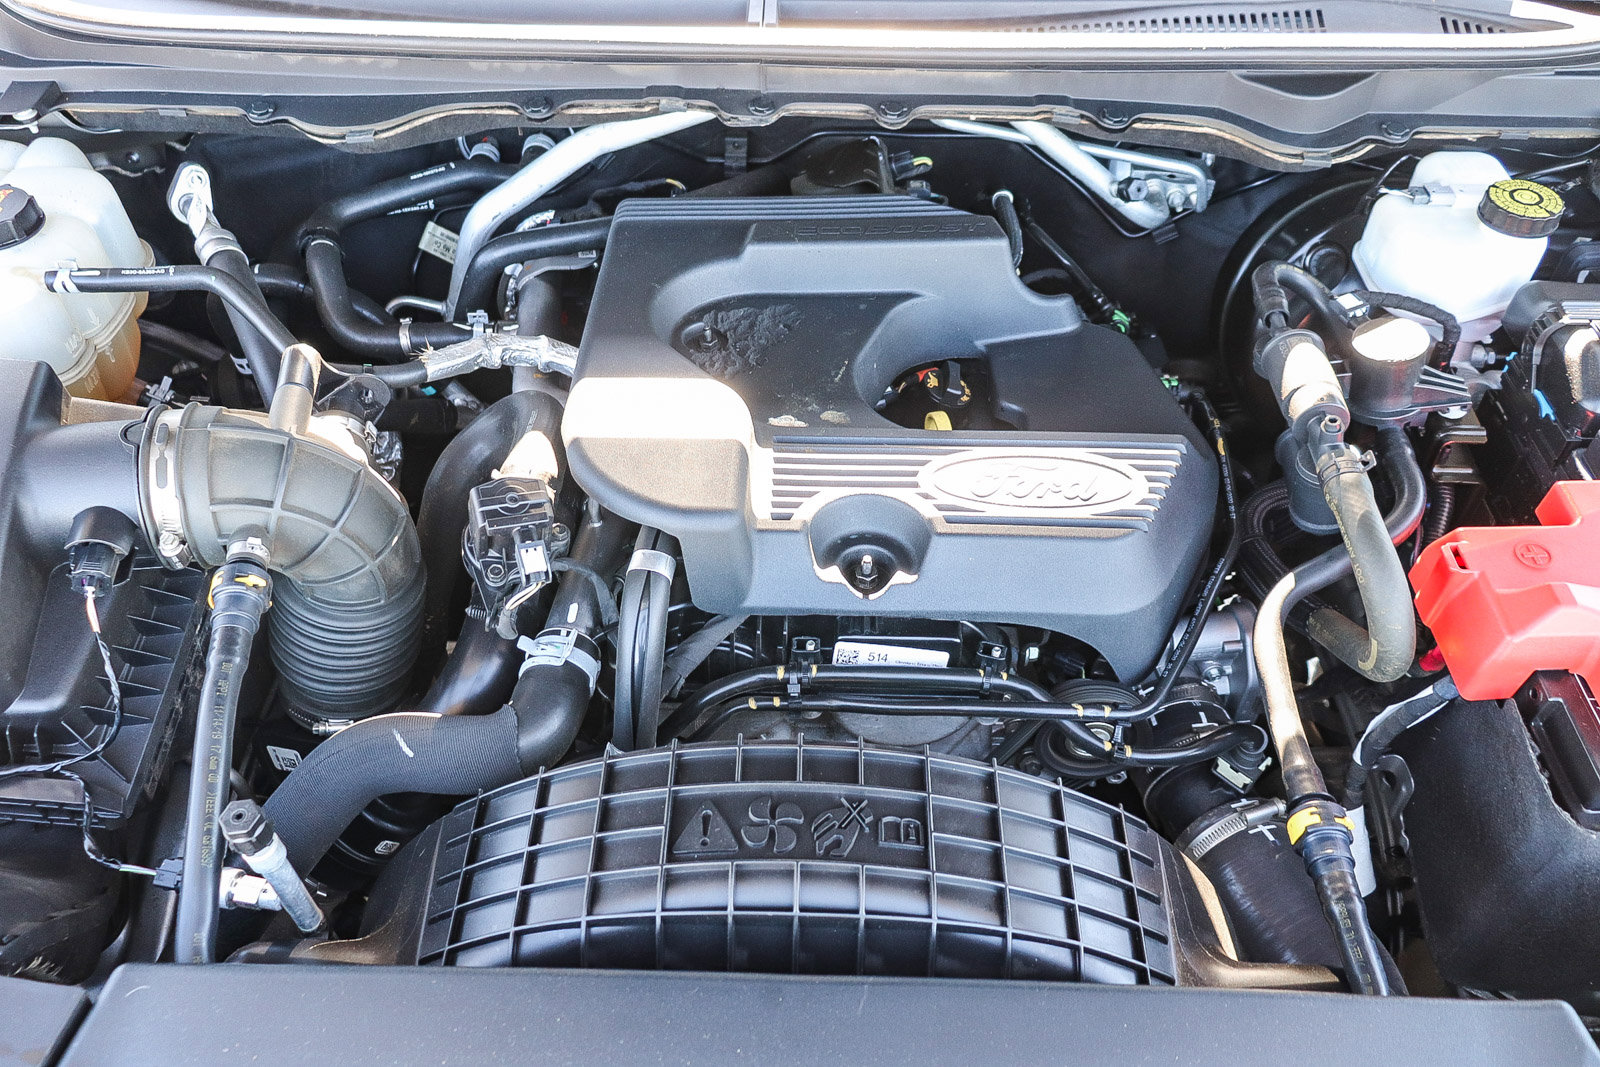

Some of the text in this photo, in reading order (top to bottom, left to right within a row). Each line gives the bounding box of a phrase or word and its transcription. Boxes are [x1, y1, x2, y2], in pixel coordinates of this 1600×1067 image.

[797, 222, 986, 236] ECOBOOST
[968, 462, 1099, 502] Ford
[1354, 563, 1365, 584] DOT
[867, 651, 889, 663] 514
